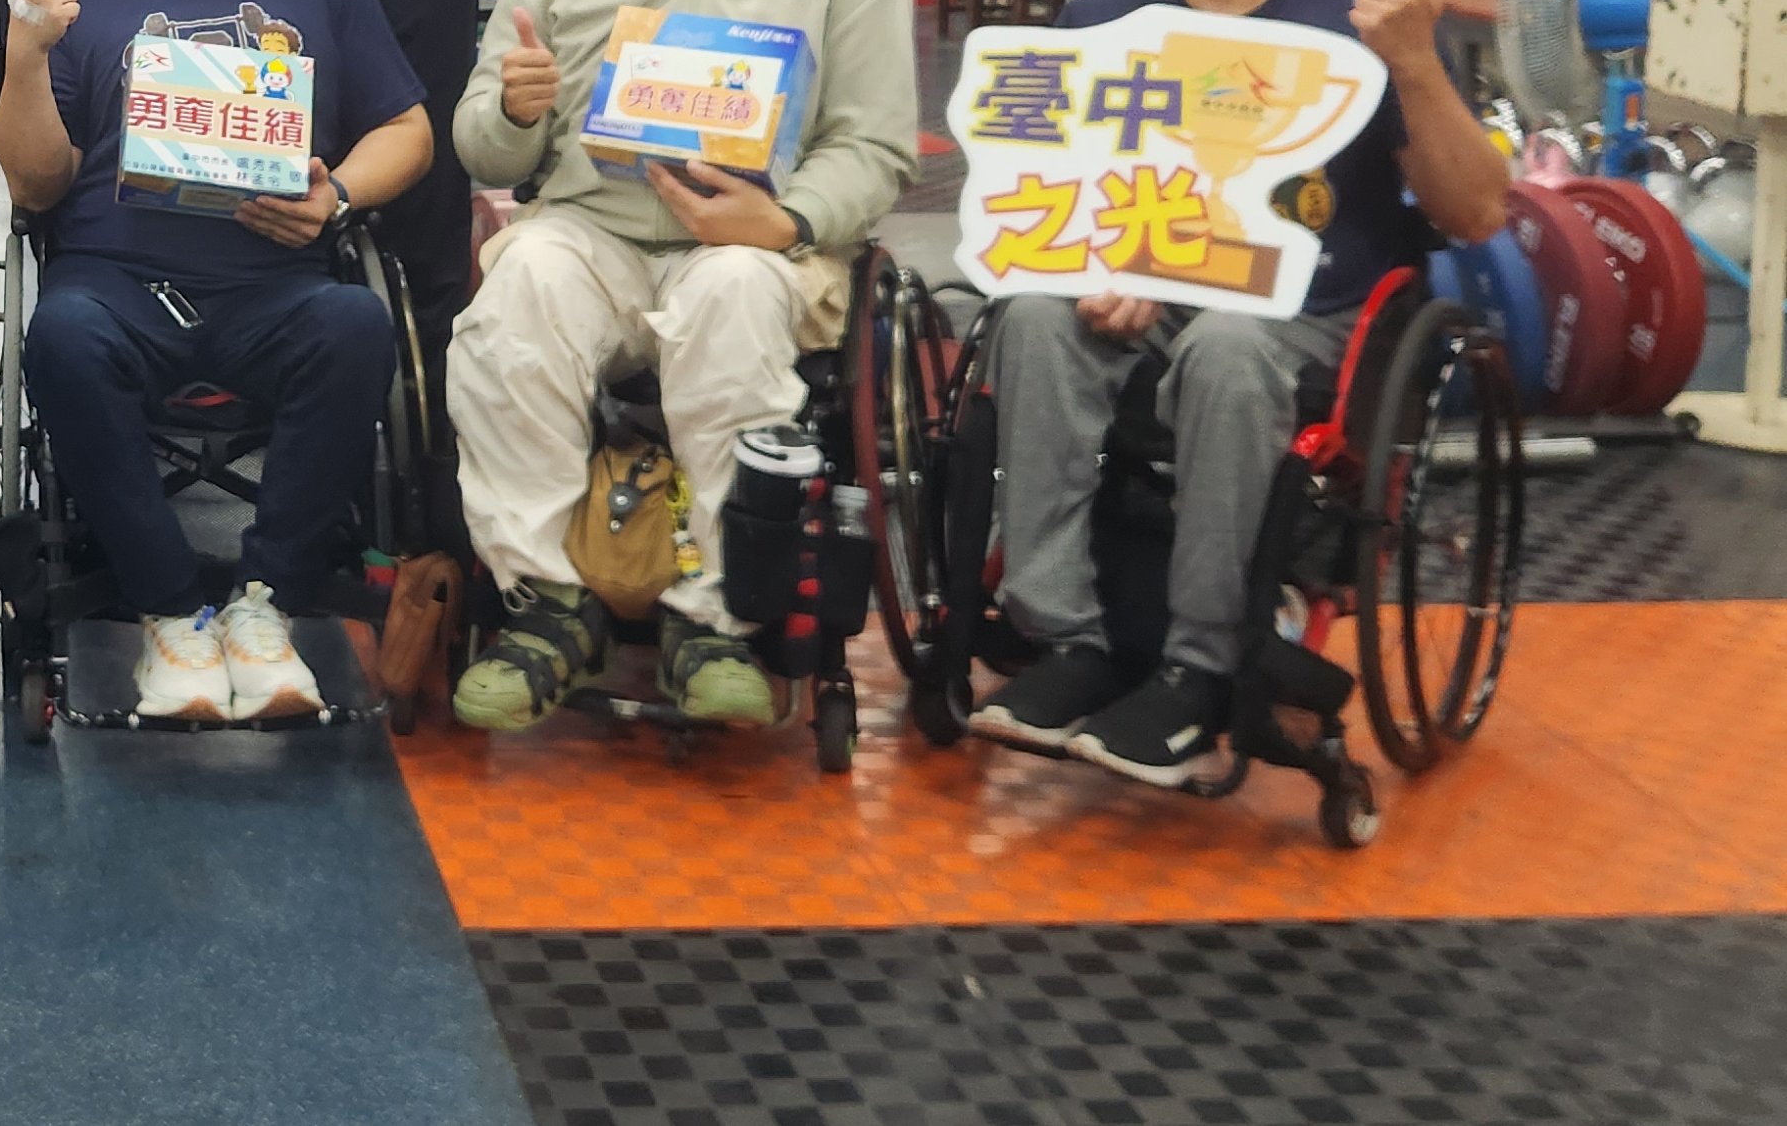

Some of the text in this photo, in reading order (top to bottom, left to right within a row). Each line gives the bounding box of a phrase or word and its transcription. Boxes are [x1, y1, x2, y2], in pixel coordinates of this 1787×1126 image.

[127, 90, 304, 149] 勇奪佳績
[971, 49, 1184, 152] 臺中
[978, 164, 1211, 279] 之光
